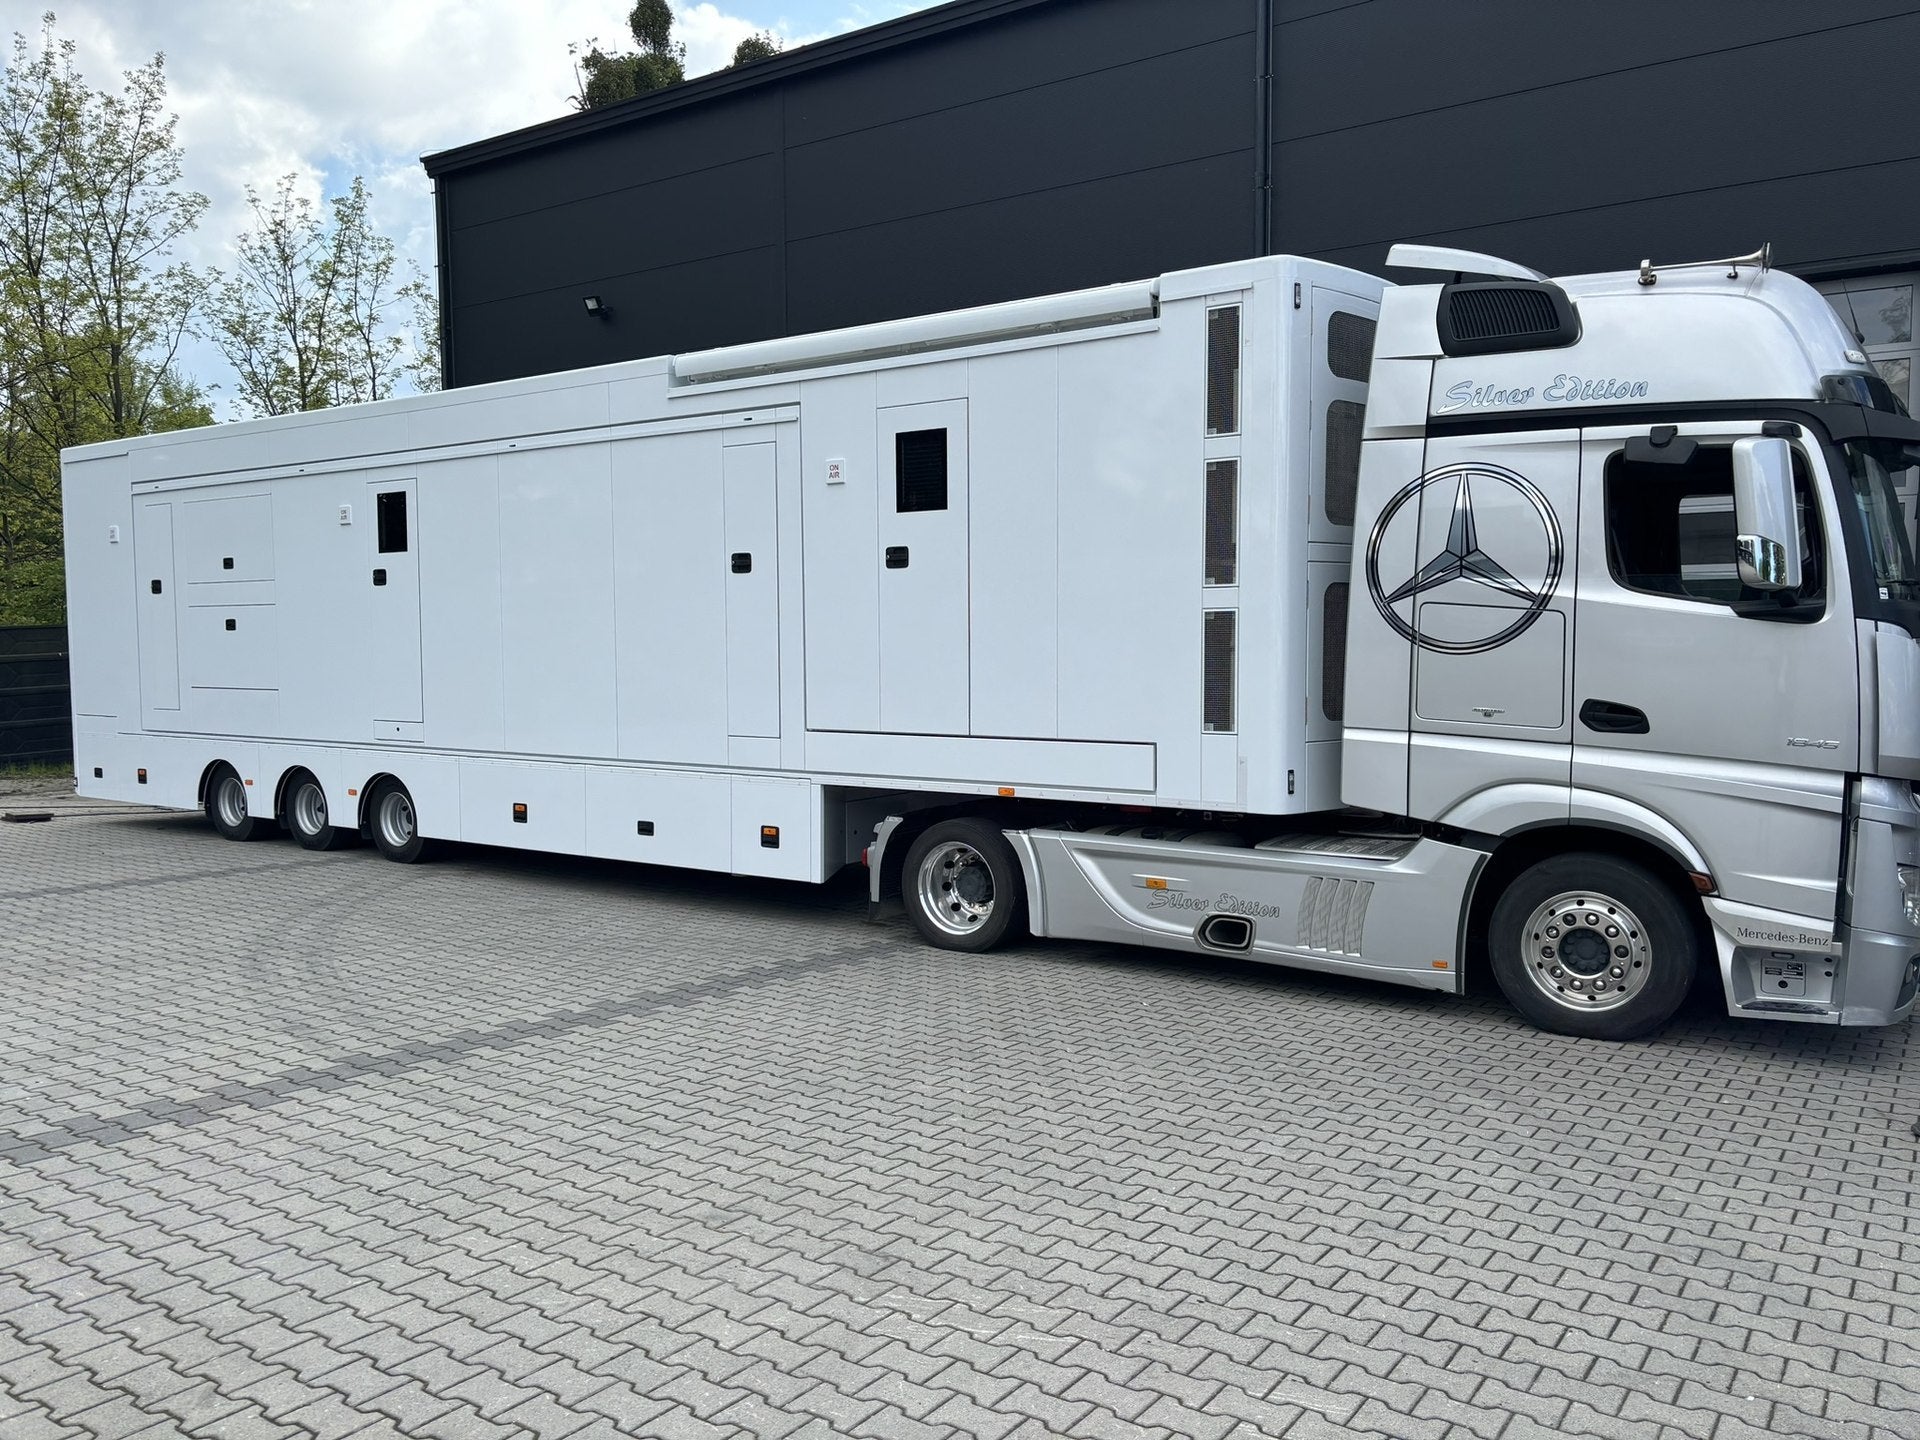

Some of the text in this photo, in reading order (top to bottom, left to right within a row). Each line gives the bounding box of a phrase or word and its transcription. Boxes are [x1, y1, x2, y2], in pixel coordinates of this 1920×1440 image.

[1437, 374, 1648, 414] Silver Edition
[829, 471, 840, 479] AIR
[1147, 889, 1280, 918] Silver Edition
[1737, 927, 1829, 947] Mercedes-Benz
